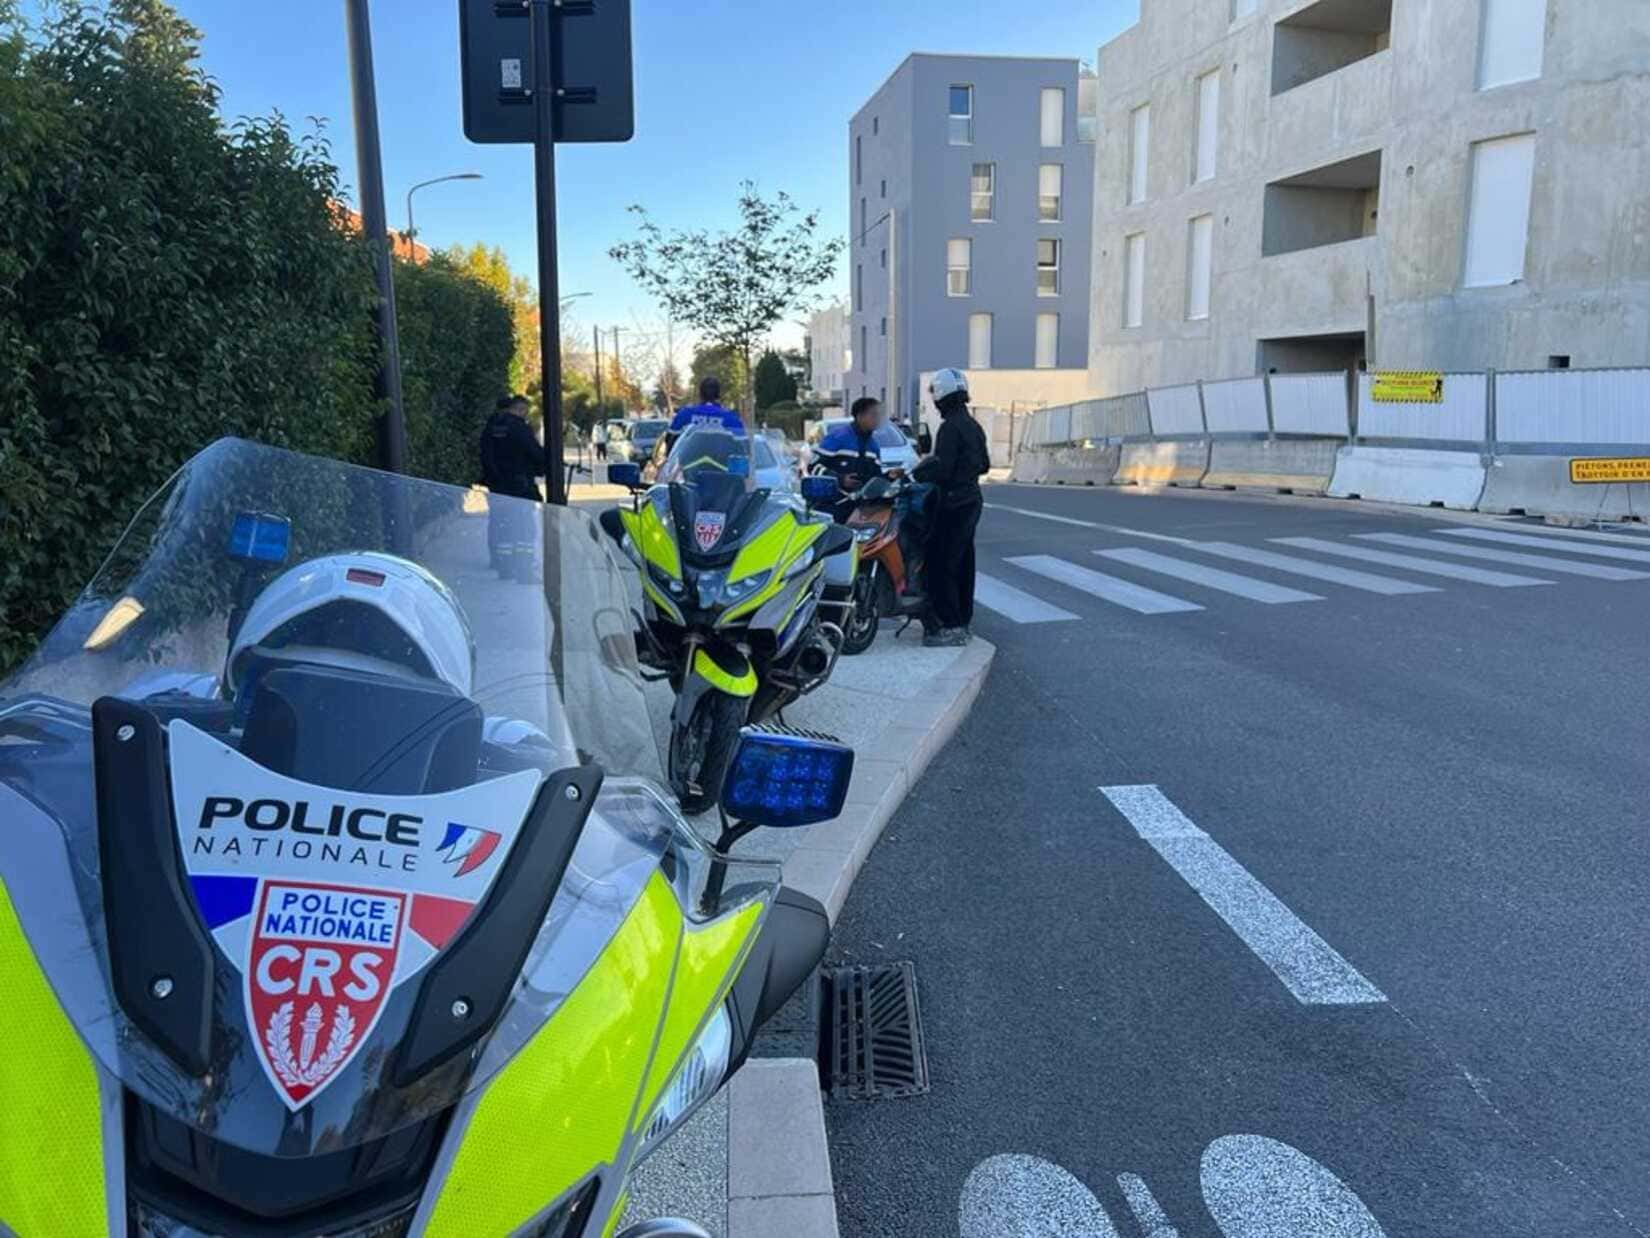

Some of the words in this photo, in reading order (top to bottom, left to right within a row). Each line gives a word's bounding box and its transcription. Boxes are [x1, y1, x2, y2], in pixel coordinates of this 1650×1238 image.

[199, 797, 423, 847] POLICE
[193, 836, 419, 872] NATIONALE
[282, 892, 387, 920] POLICE
[266, 914, 394, 943] NATIONALE
[256, 944, 384, 1002] CRS
